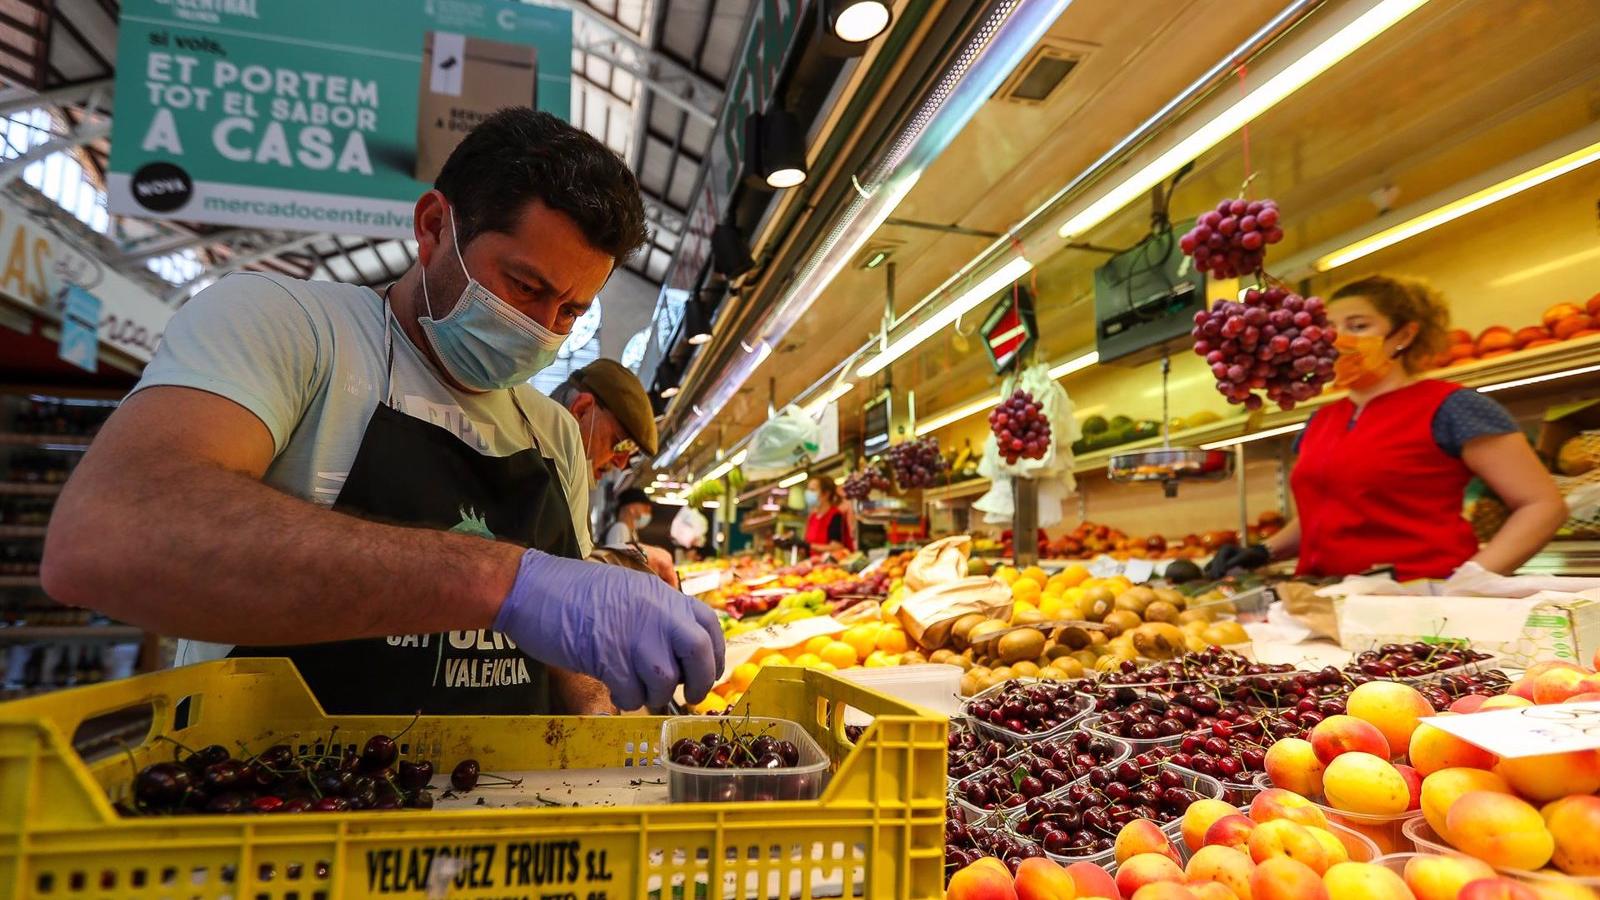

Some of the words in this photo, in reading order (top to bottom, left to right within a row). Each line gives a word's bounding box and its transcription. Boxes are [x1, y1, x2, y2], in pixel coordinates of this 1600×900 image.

[146, 52, 199, 84] ET
[213, 60, 379, 109] PORTEM
[145, 81, 213, 111] TOT
[223, 91, 259, 119] EL
[271, 97, 378, 133] SABOR
[142, 108, 184, 155] A
[211, 117, 374, 176] CASA
[135, 177, 188, 198] NOVA
[202, 194, 414, 229] mercadocentralva
[445, 657, 531, 687] VALÈNCIA
[504, 841, 581, 886] FRUITS
